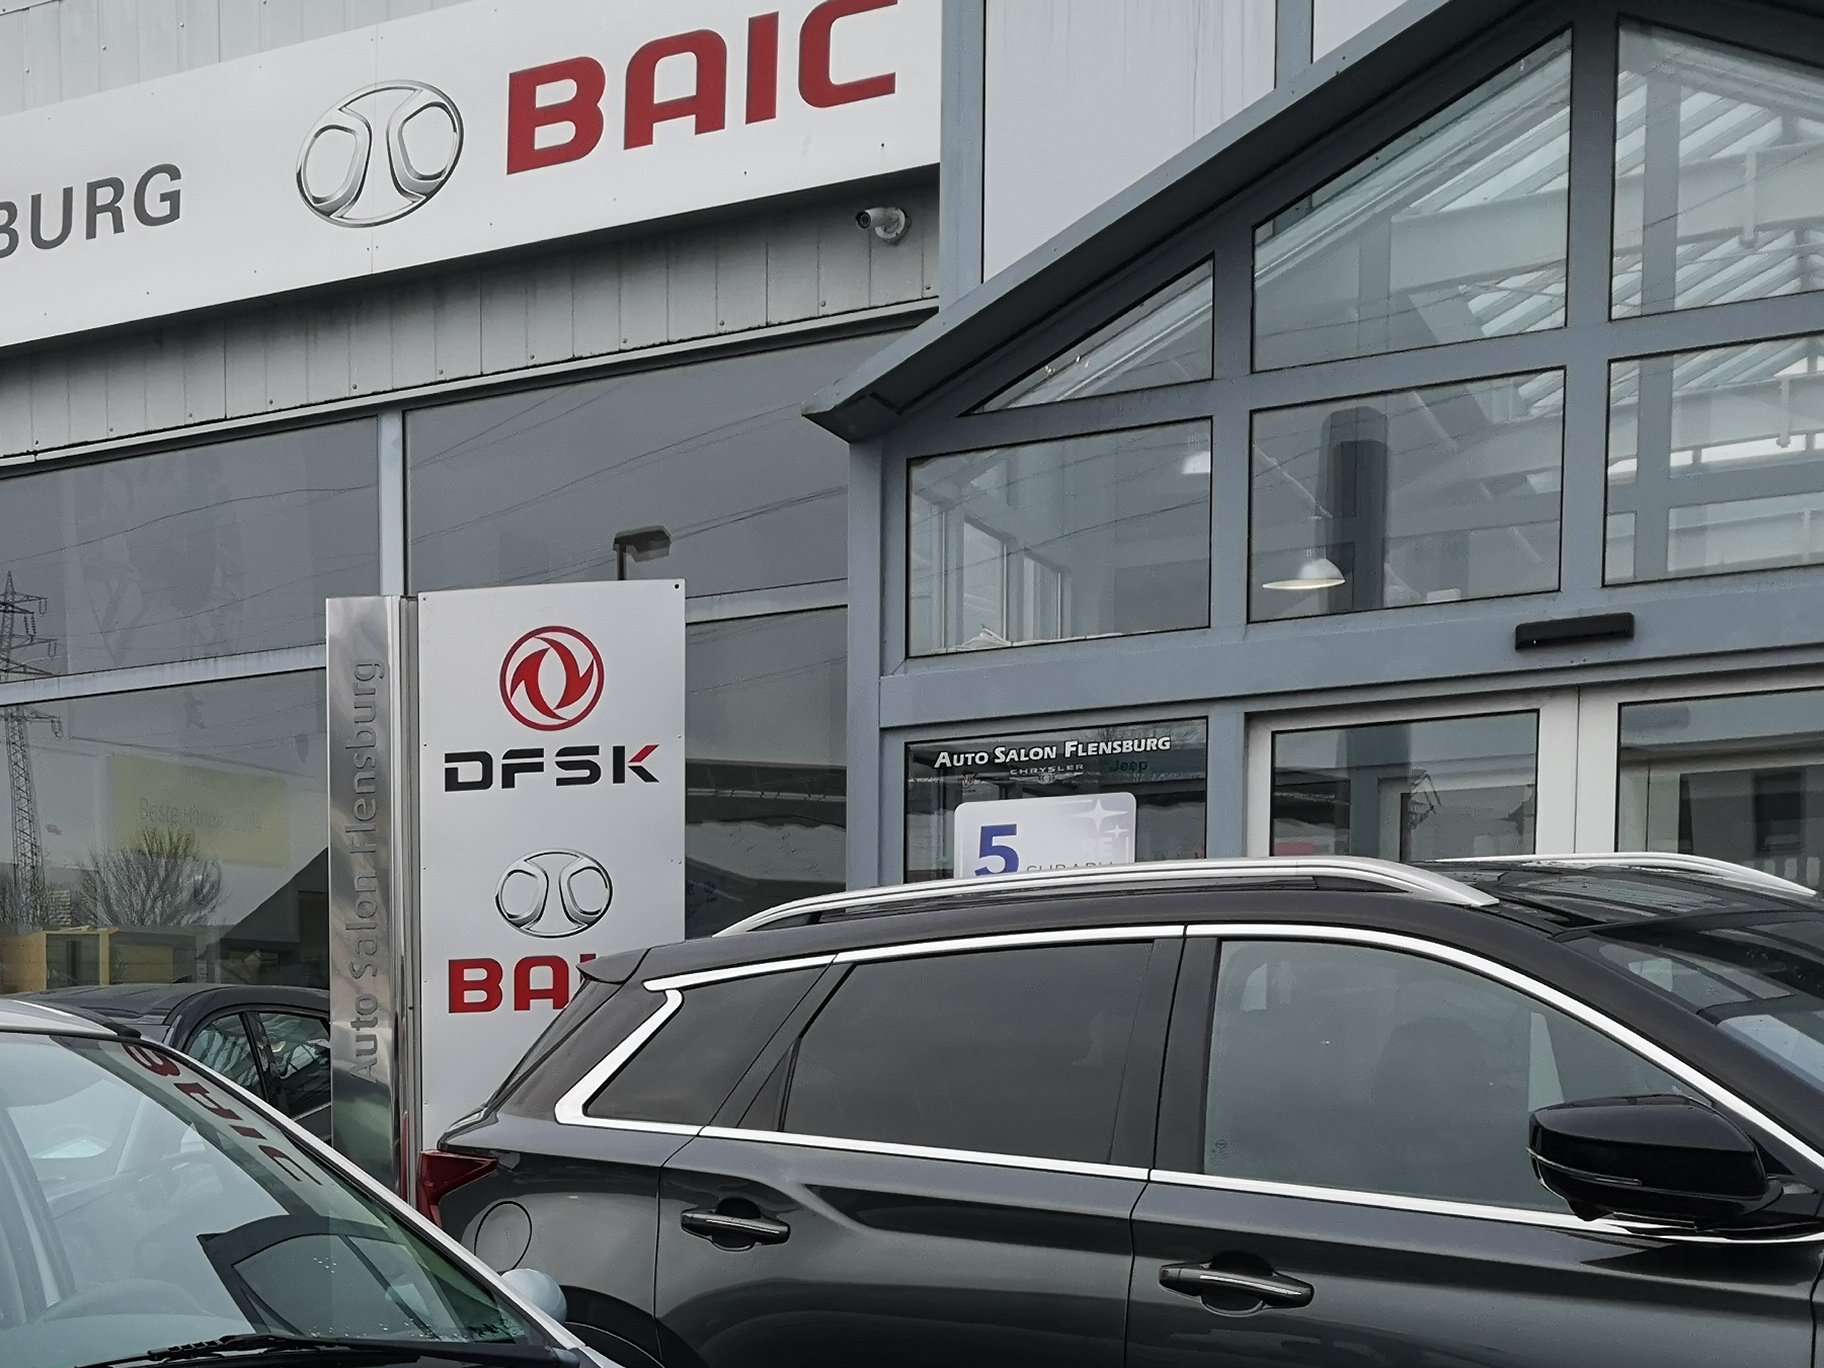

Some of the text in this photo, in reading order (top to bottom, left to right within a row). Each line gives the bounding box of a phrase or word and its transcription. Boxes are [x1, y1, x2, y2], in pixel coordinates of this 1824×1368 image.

[507, 0, 898, 175] BAIC
[444, 744, 659, 792] DFSK
[934, 736, 1171, 768] AUTO SALON FLENSBURG
[1009, 763, 1084, 776] CHRYSLER
[345, 662, 385, 1080] Auto Salon Flensburg
[975, 824, 1019, 875] 5
[449, 954, 596, 1013] BA
